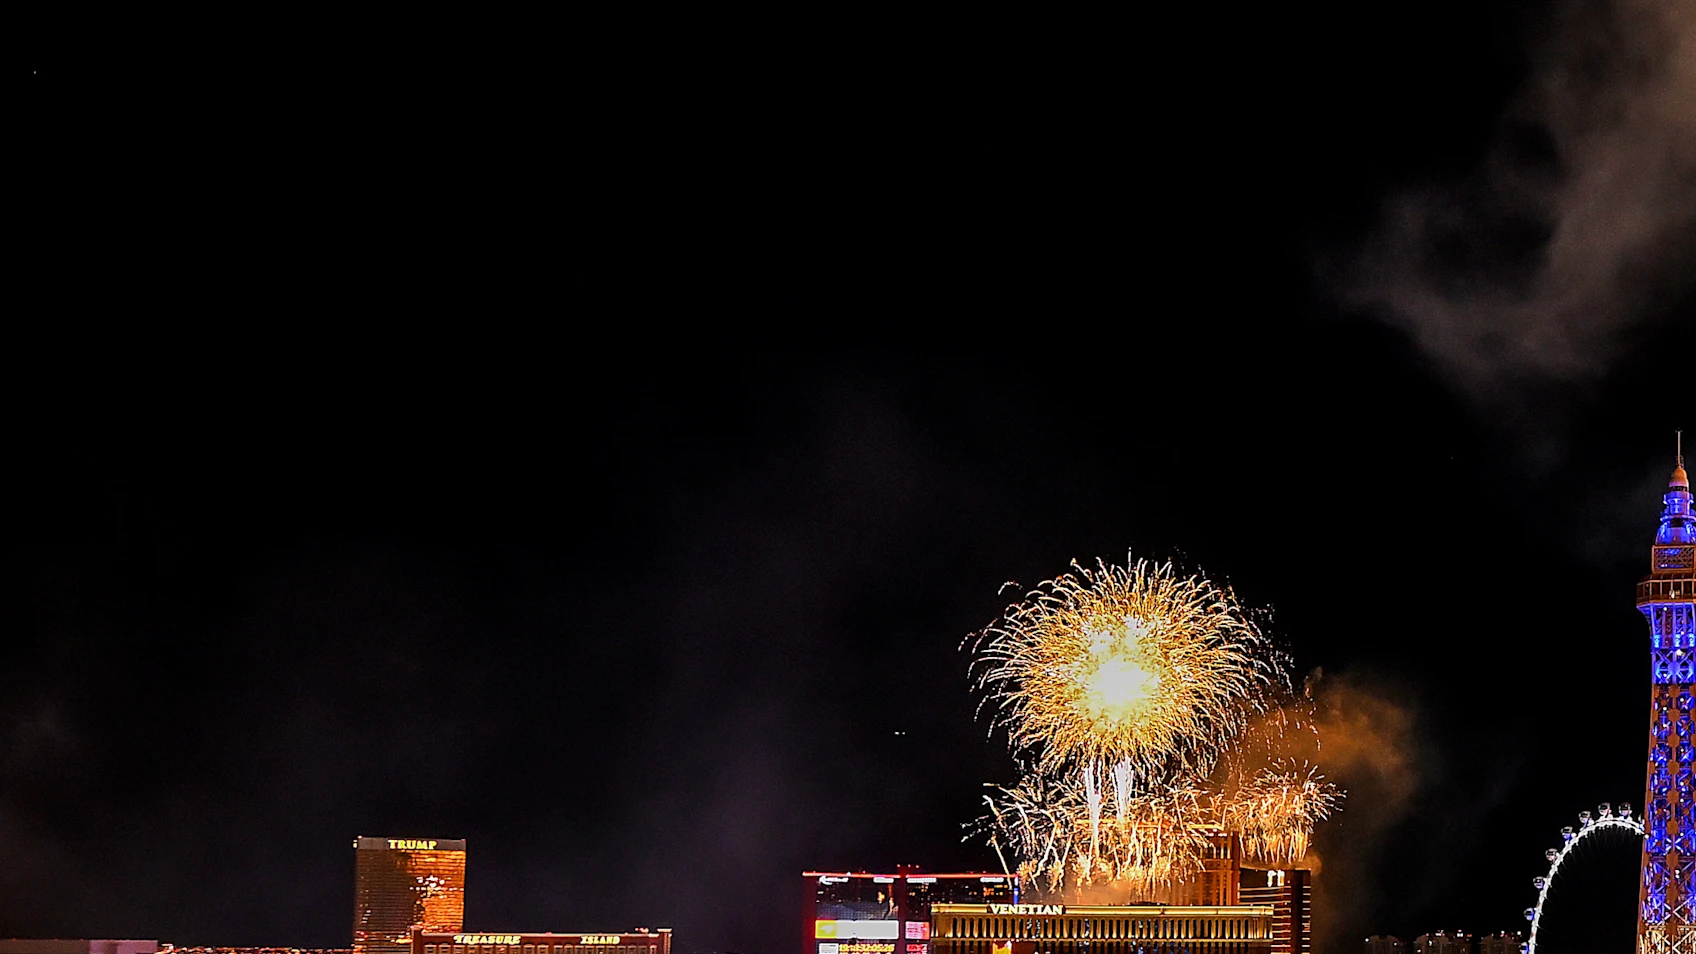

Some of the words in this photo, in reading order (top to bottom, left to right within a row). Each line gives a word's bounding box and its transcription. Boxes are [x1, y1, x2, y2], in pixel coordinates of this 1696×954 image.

[387, 839, 438, 850] TRUMP
[989, 903, 1063, 916] VENETIAN
[453, 935, 522, 945] TREASURE
[580, 935, 621, 945] ISLAND
